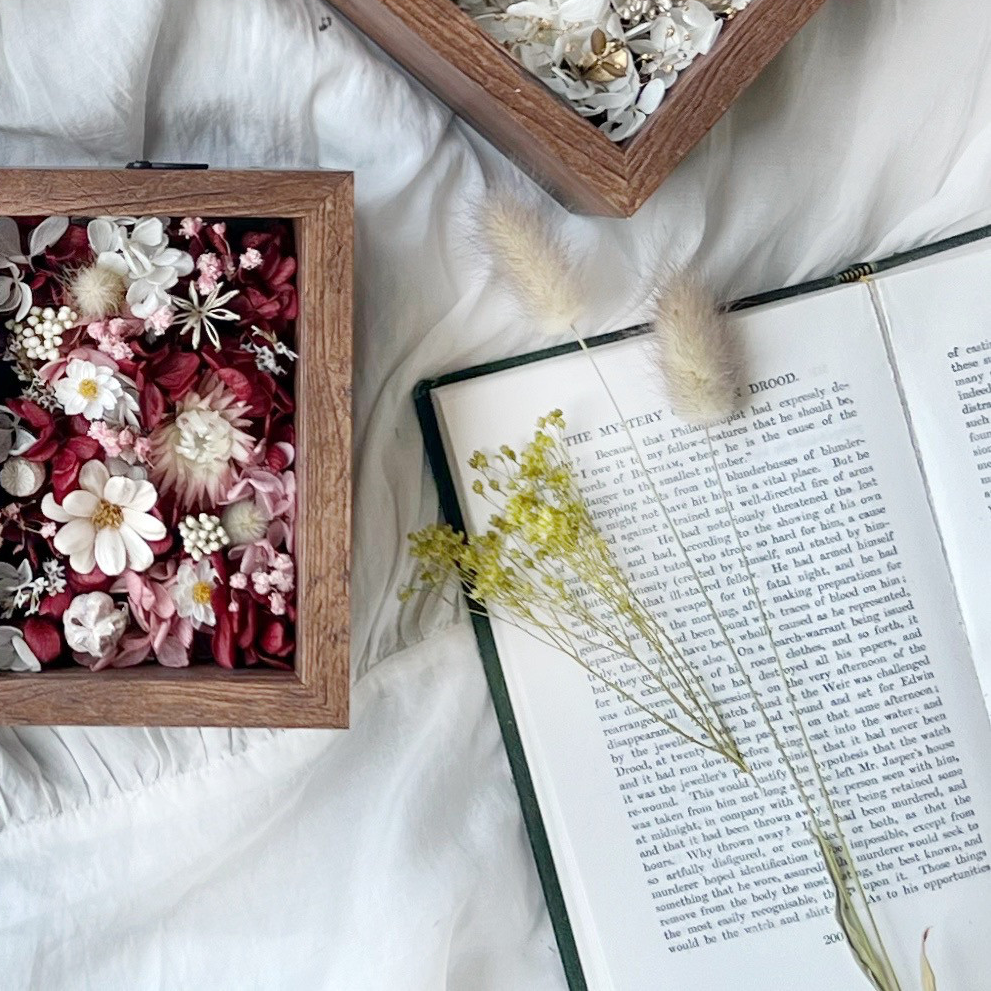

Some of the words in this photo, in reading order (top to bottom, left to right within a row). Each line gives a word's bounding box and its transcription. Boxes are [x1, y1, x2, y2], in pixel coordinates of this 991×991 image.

[947, 346, 959, 359] of
[951, 360, 978, 373] these
[954, 373, 984, 387] many
[562, 430, 591, 446] THE
[748, 373, 799, 394] DROOD.
[749, 401, 772, 415] had
[752, 416, 776, 430] that
[797, 397, 832, 417] should
[965, 415, 990, 428] such
[761, 431, 780, 442] the
[786, 422, 814, 435] cause
[659, 465, 700, 485] smallest
[673, 484, 699, 496] from
[819, 438, 865, 455] blunder-
[604, 511, 637, 530] might
[640, 508, 659, 521] not
[762, 471, 787, 486] vital
[790, 466, 821, 482] place.
[619, 524, 658, 542] against
[672, 507, 710, 526] trained
[848, 465, 874, 477] arms
[776, 510, 820, 527] showing
[838, 499, 856, 510] his
[859, 492, 882, 504] own
[622, 542, 643, 555] too.
[856, 477, 878, 490] lost
[694, 552, 716, 563] who
[770, 528, 796, 544] hard
[817, 517, 845, 530] him,
[858, 506, 885, 519] cause
[784, 540, 805, 555] and
[809, 531, 841, 548] stated
[791, 553, 814, 568] had
[819, 542, 852, 560] armed
[854, 530, 894, 550] himself
[766, 574, 791, 590] fatal
[797, 566, 830, 582] night,
[834, 557, 854, 571] and
[772, 587, 812, 603] making
[779, 599, 810, 616] traces
[828, 586, 859, 602] blood
[878, 575, 906, 588] him;
[849, 610, 881, 626] being
[883, 599, 914, 617] issued
[785, 643, 825, 659] clothes,
[873, 619, 904, 634] forth,
[834, 649, 852, 660] his
[858, 639, 896, 657] papers,
[902, 626, 922, 641] and
[808, 670, 830, 682] very
[821, 679, 849, 692] Weir
[853, 674, 872, 684] was
[830, 692, 850, 706] and
[900, 668, 934, 686] Edwin
[833, 723, 856, 735] into
[883, 706, 919, 720] water;
[923, 695, 943, 710] and
[614, 759, 652, 777] Drood,
[670, 745, 705, 762] twenty
[854, 702, 880, 714] same
[636, 790, 655, 799] was
[889, 721, 917, 734] never
[688, 787, 714, 800] This
[920, 724, 951, 740] watch
[653, 812, 683, 825] taken
[714, 798, 736, 809] him
[834, 766, 854, 779] left
[857, 761, 878, 772] Mr.
[881, 748, 923, 766] Jasper's
[924, 740, 955, 754] house
[719, 805, 765, 822] company
[843, 777, 878, 795] person
[908, 759, 932, 773] with
[662, 838, 685, 852] that
[753, 813, 791, 828] thrown
[856, 789, 887, 802] being
[890, 773, 933, 794] retained
[665, 863, 704, 880] artfully
[868, 815, 899, 829] both,
[685, 847, 714, 859] Why
[757, 826, 790, 842] away?
[855, 844, 904, 862] murderer
[907, 831, 938, 848] would
[651, 881, 698, 899] murderer
[699, 902, 725, 916] from
[750, 888, 777, 902] body
[897, 853, 920, 866] best
[923, 844, 962, 859] known,
[716, 911, 745, 926] easily
[917, 861, 950, 874] Those
[954, 849, 987, 864] things
[667, 936, 699, 952] would
[823, 932, 844, 945] 200
